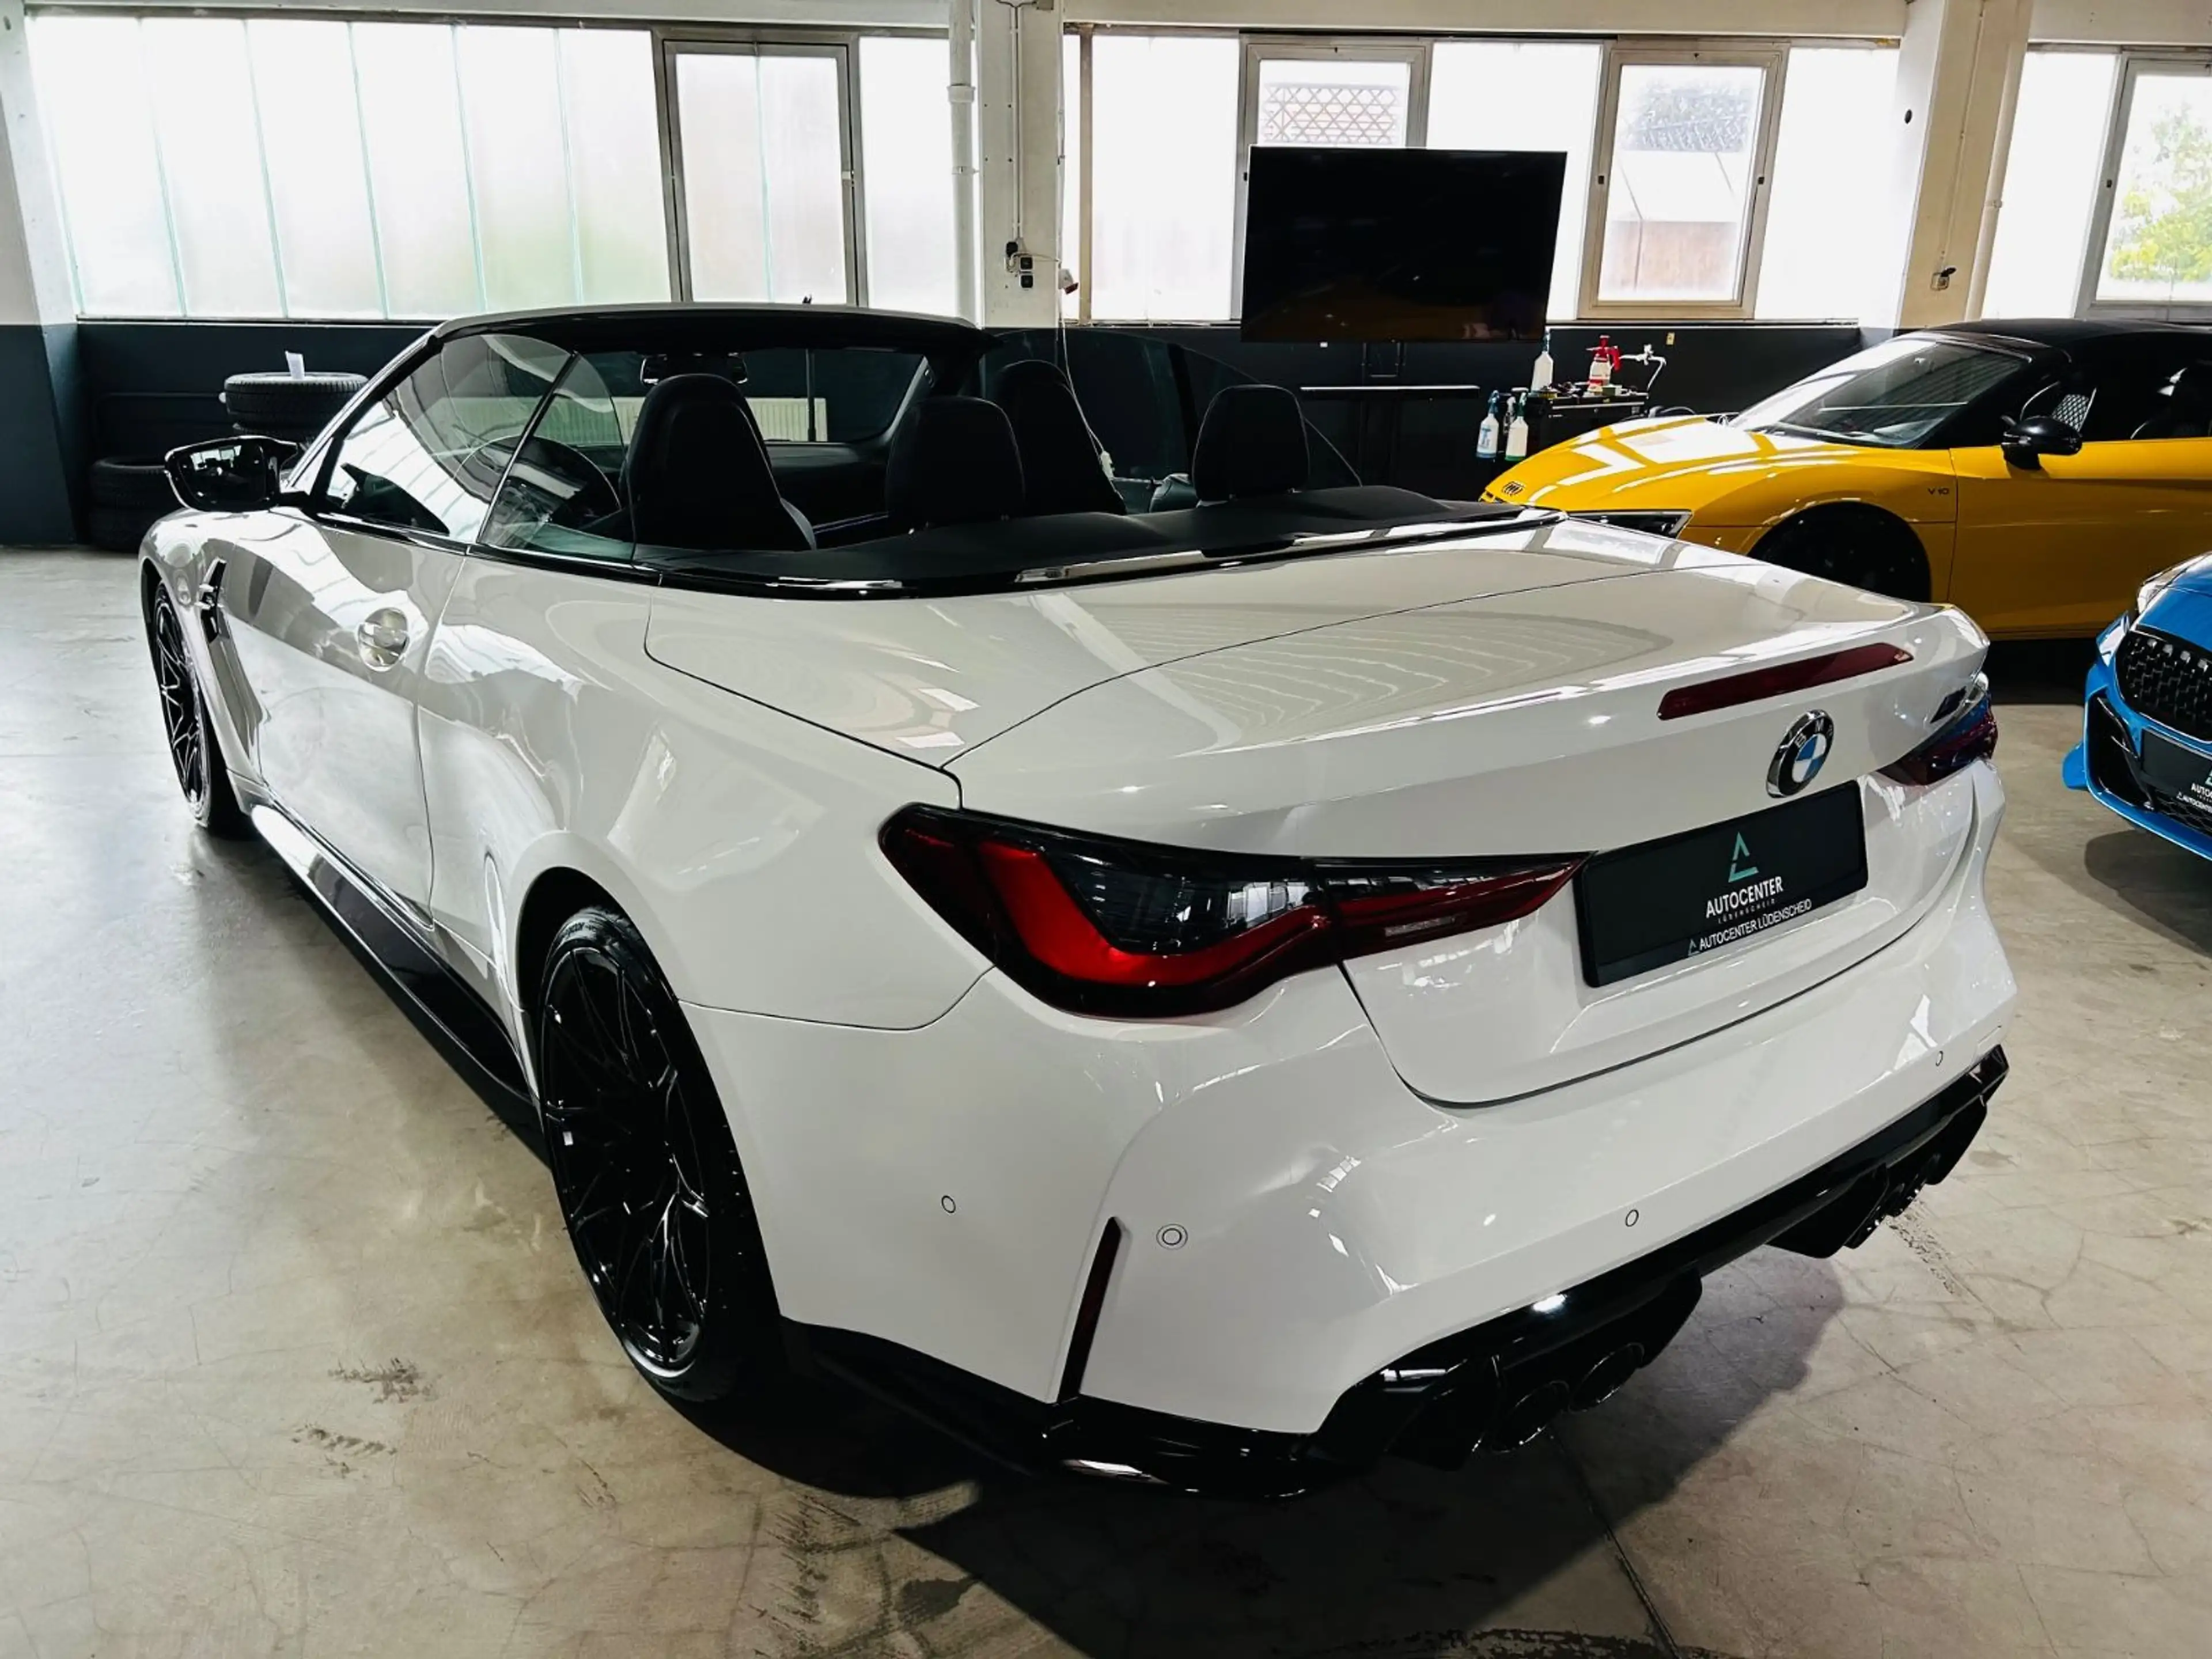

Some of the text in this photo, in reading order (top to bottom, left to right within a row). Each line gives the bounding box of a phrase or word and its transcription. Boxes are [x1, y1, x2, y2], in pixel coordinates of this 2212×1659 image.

[1706, 876, 1783, 918] AUTOCENTER
[1699, 899, 1812, 950] AUTOCENTER LÜDENSCHEID
